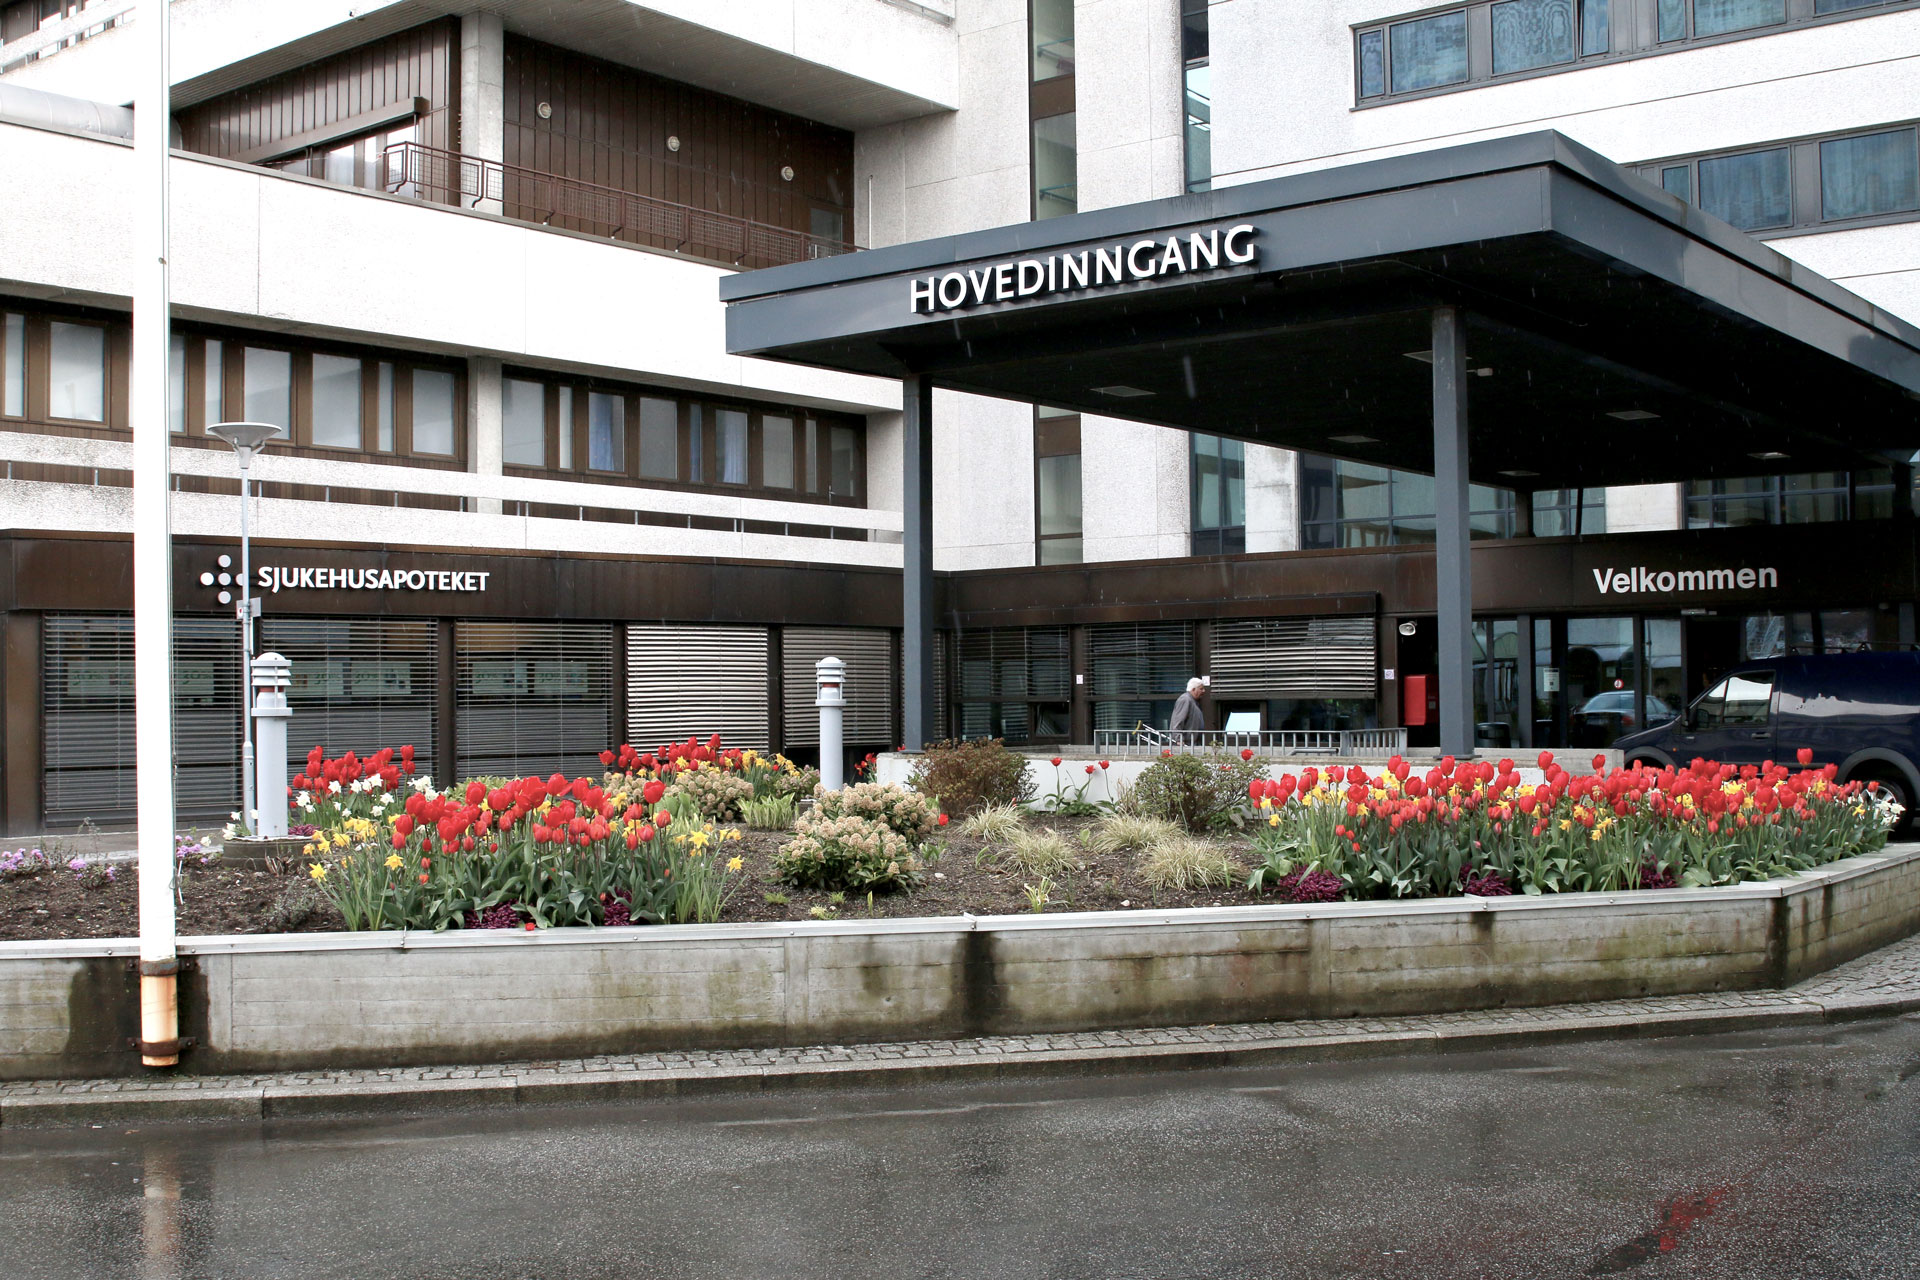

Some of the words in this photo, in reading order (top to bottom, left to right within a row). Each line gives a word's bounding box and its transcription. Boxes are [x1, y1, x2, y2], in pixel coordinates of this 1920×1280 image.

[909, 224, 1255, 313] HOVEDINNGANG
[257, 566, 490, 593] SJUKEHUSAPOTEKET
[1593, 566, 1778, 594] Velkommen
